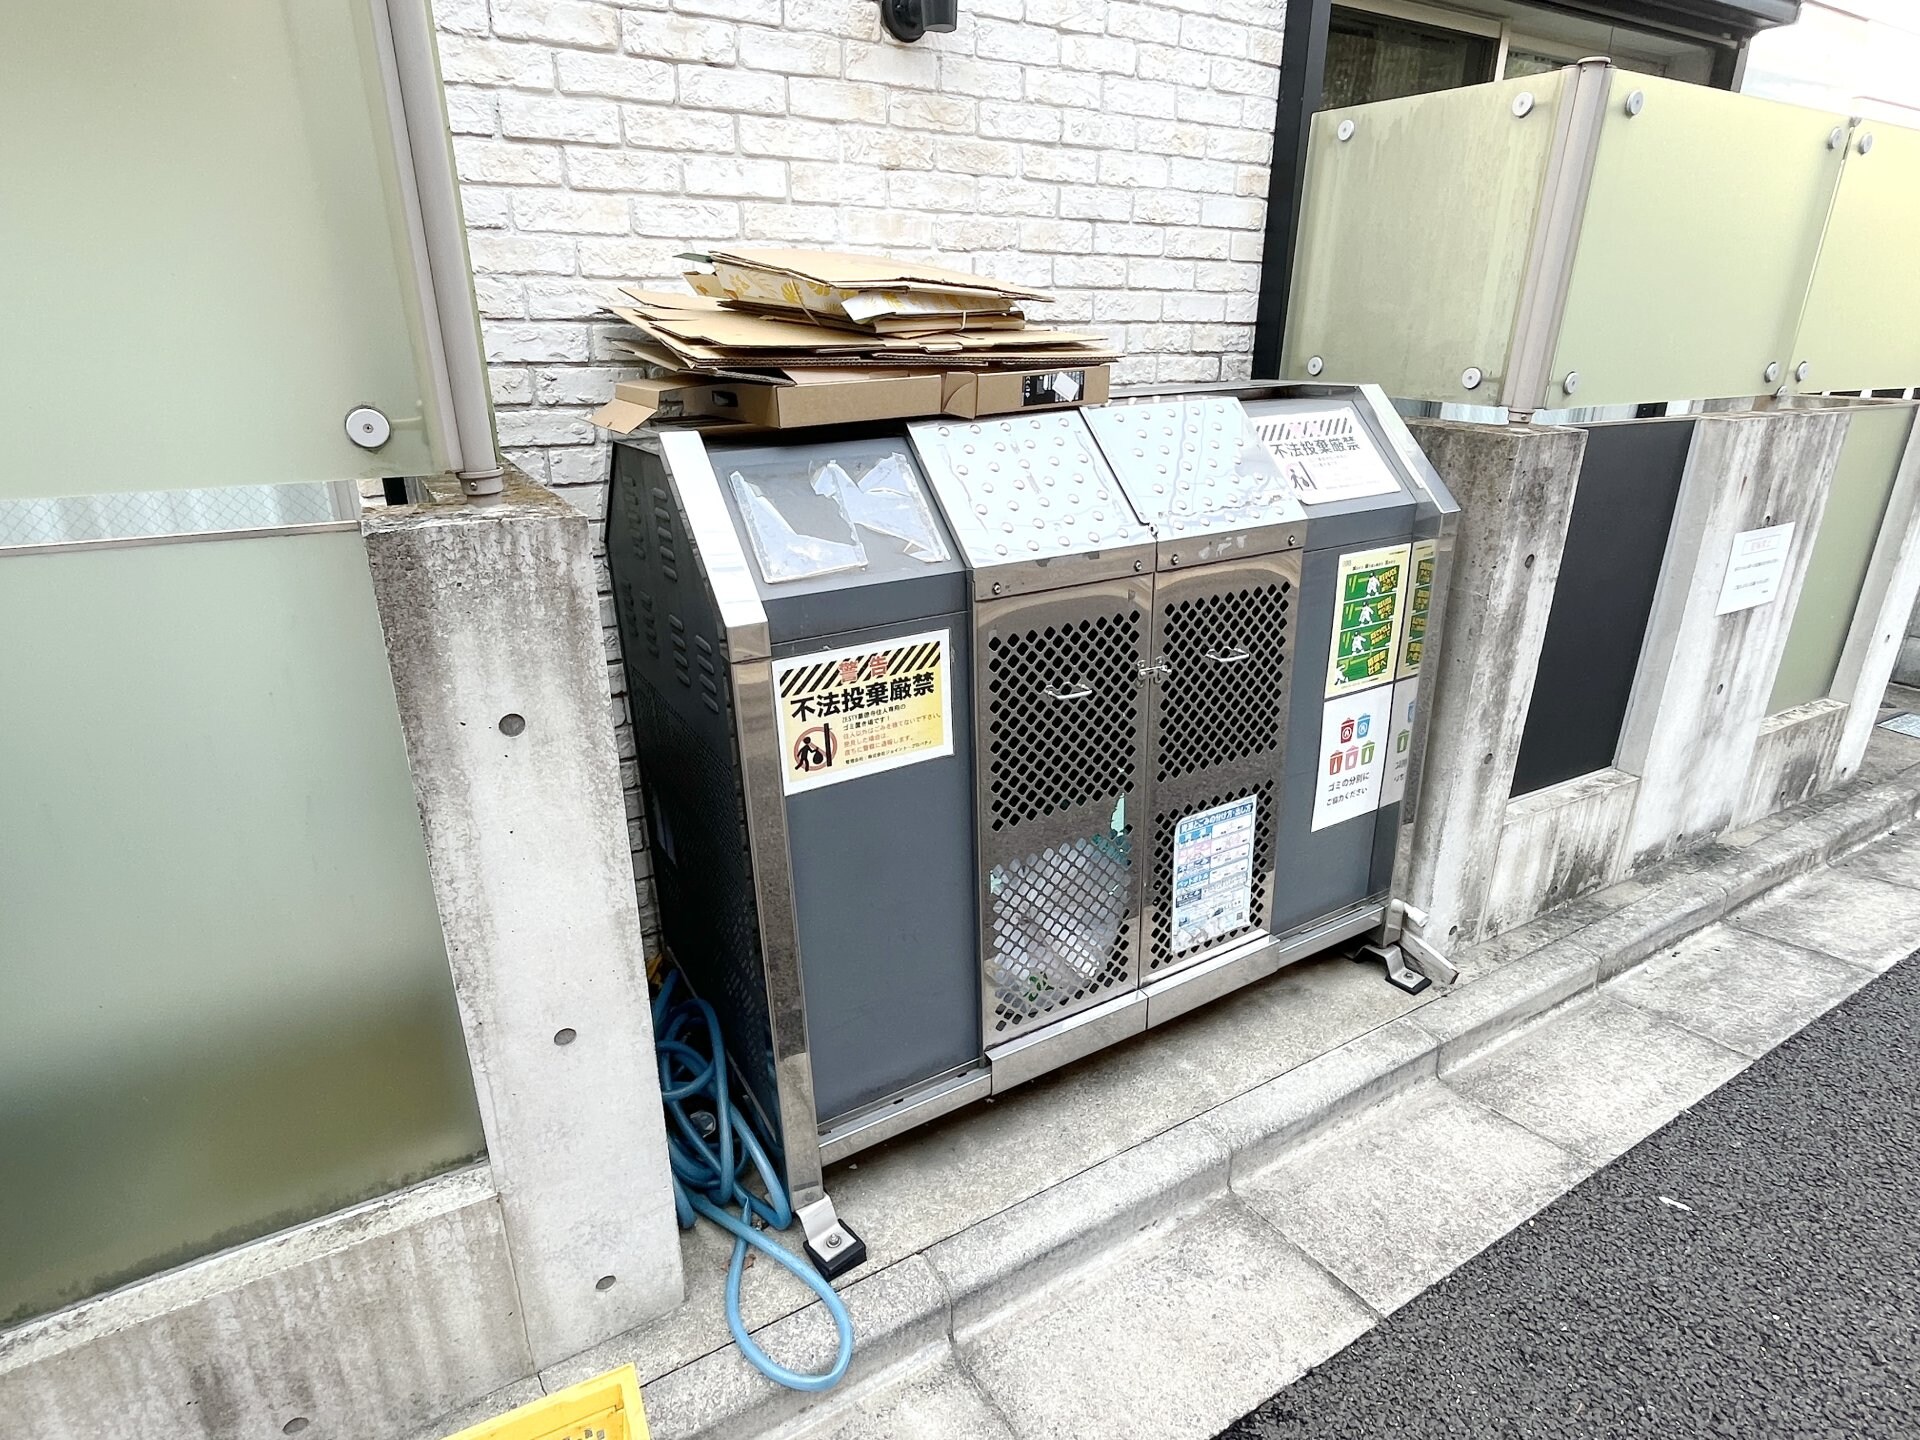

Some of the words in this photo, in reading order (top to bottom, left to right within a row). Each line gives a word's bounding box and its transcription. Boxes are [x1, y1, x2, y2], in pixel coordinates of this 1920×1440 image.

[1270, 437, 1360, 458] 不法投棄厳禁
[838, 655, 889, 684] 警告
[791, 671, 934, 722] 不法投棄厳禁
[1328, 772, 1370, 792] ゴミの分別に
[1326, 788, 1368, 806] ご協力ください
